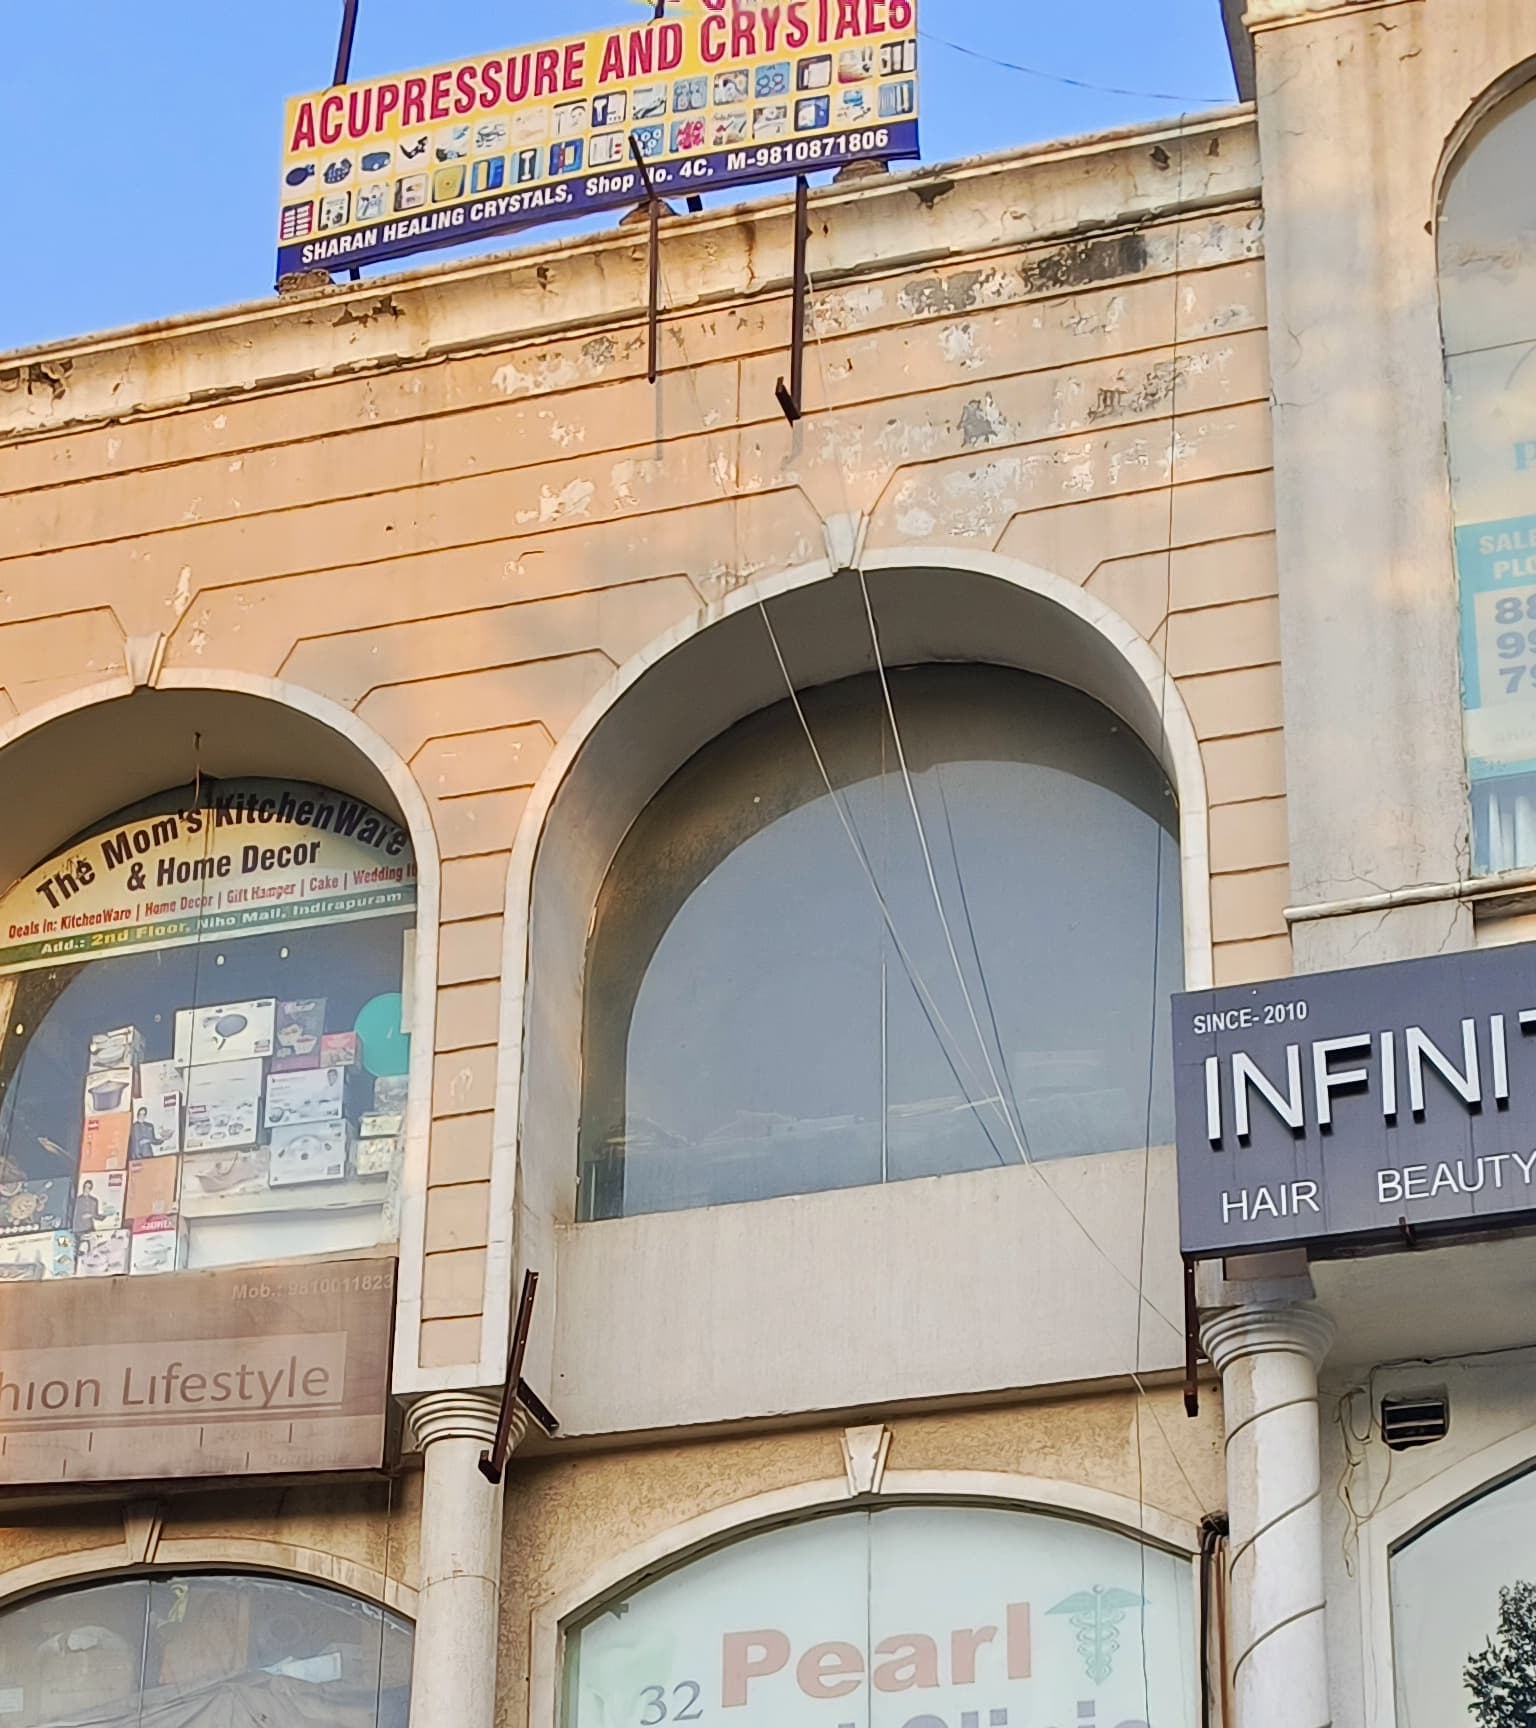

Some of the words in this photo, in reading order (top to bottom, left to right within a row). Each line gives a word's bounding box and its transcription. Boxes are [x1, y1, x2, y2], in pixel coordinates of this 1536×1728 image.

[290, 41, 586, 153] ACUPRESSURE
[599, 23, 684, 83] AND
[302, 227, 380, 264] SHARAN
[382, 208, 464, 244] HEALING
[469, 186, 574, 223] CRYSTALS,
[585, 172, 635, 198] Shop
[726, 128, 889, 173] M-9810871806
[35, 857, 96, 910] The
[100, 806, 204, 871] Mom's
[213, 790, 409, 857] KitchenWare
[156, 848, 232, 888] Home
[241, 836, 321, 874] Decor
[1263, 1001, 1308, 1025] 2010
[1221, 1180, 1321, 1224] HAIR
[122, 1355, 331, 1407] Lifestyle
[721, 1601, 1032, 1708] Pearl
[640, 1680, 704, 1727] 32
